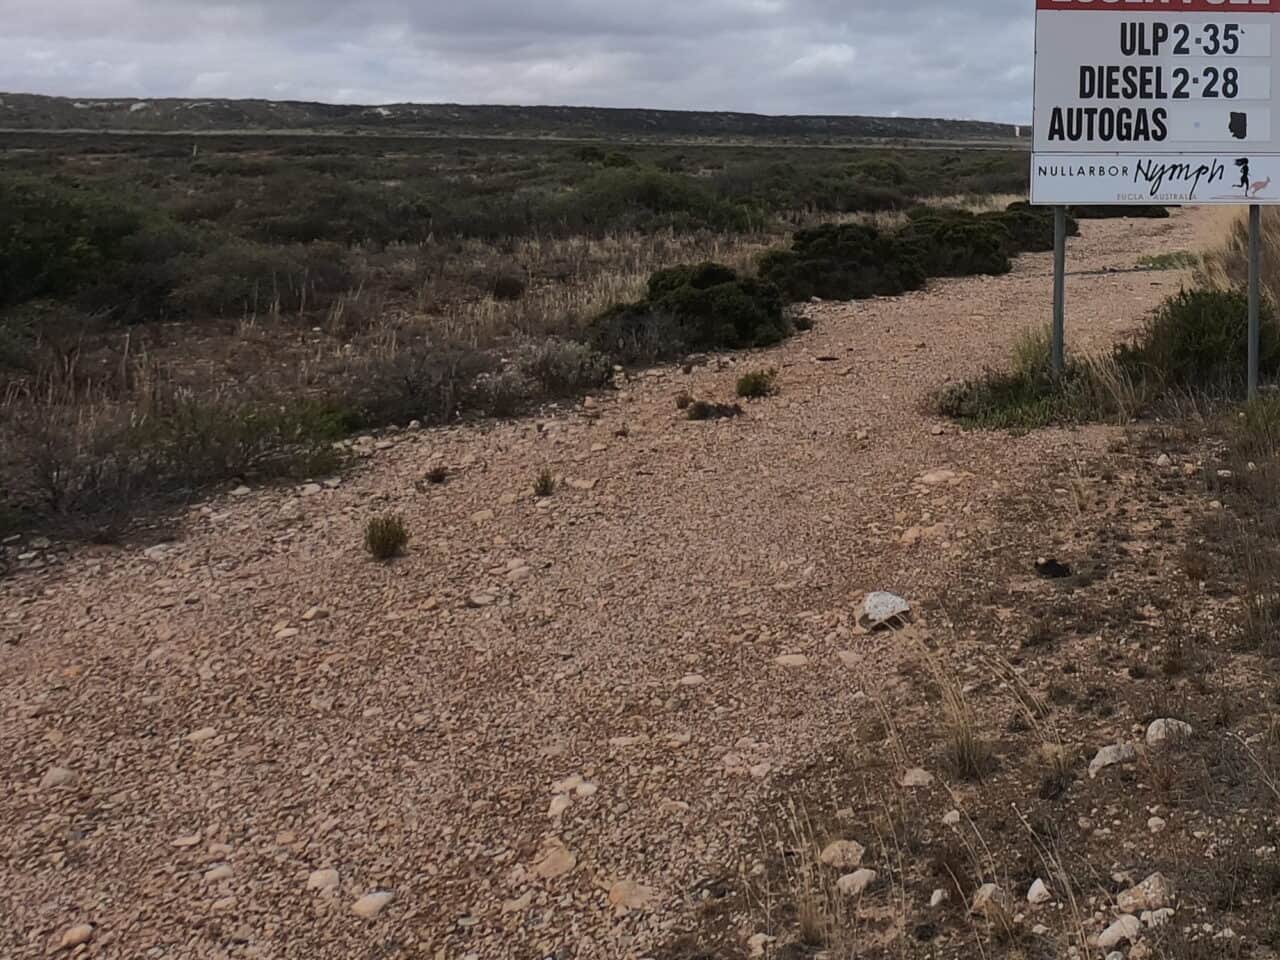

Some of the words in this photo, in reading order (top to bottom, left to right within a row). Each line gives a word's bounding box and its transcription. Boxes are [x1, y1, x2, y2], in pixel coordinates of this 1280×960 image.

[1120, 22, 1169, 56] ULP
[1079, 65, 1168, 100] DIESEL
[1048, 107, 1168, 141] AUTOGAS
[1038, 165, 1129, 177] NULLARBOR
[1133, 158, 1225, 200] Nymph
